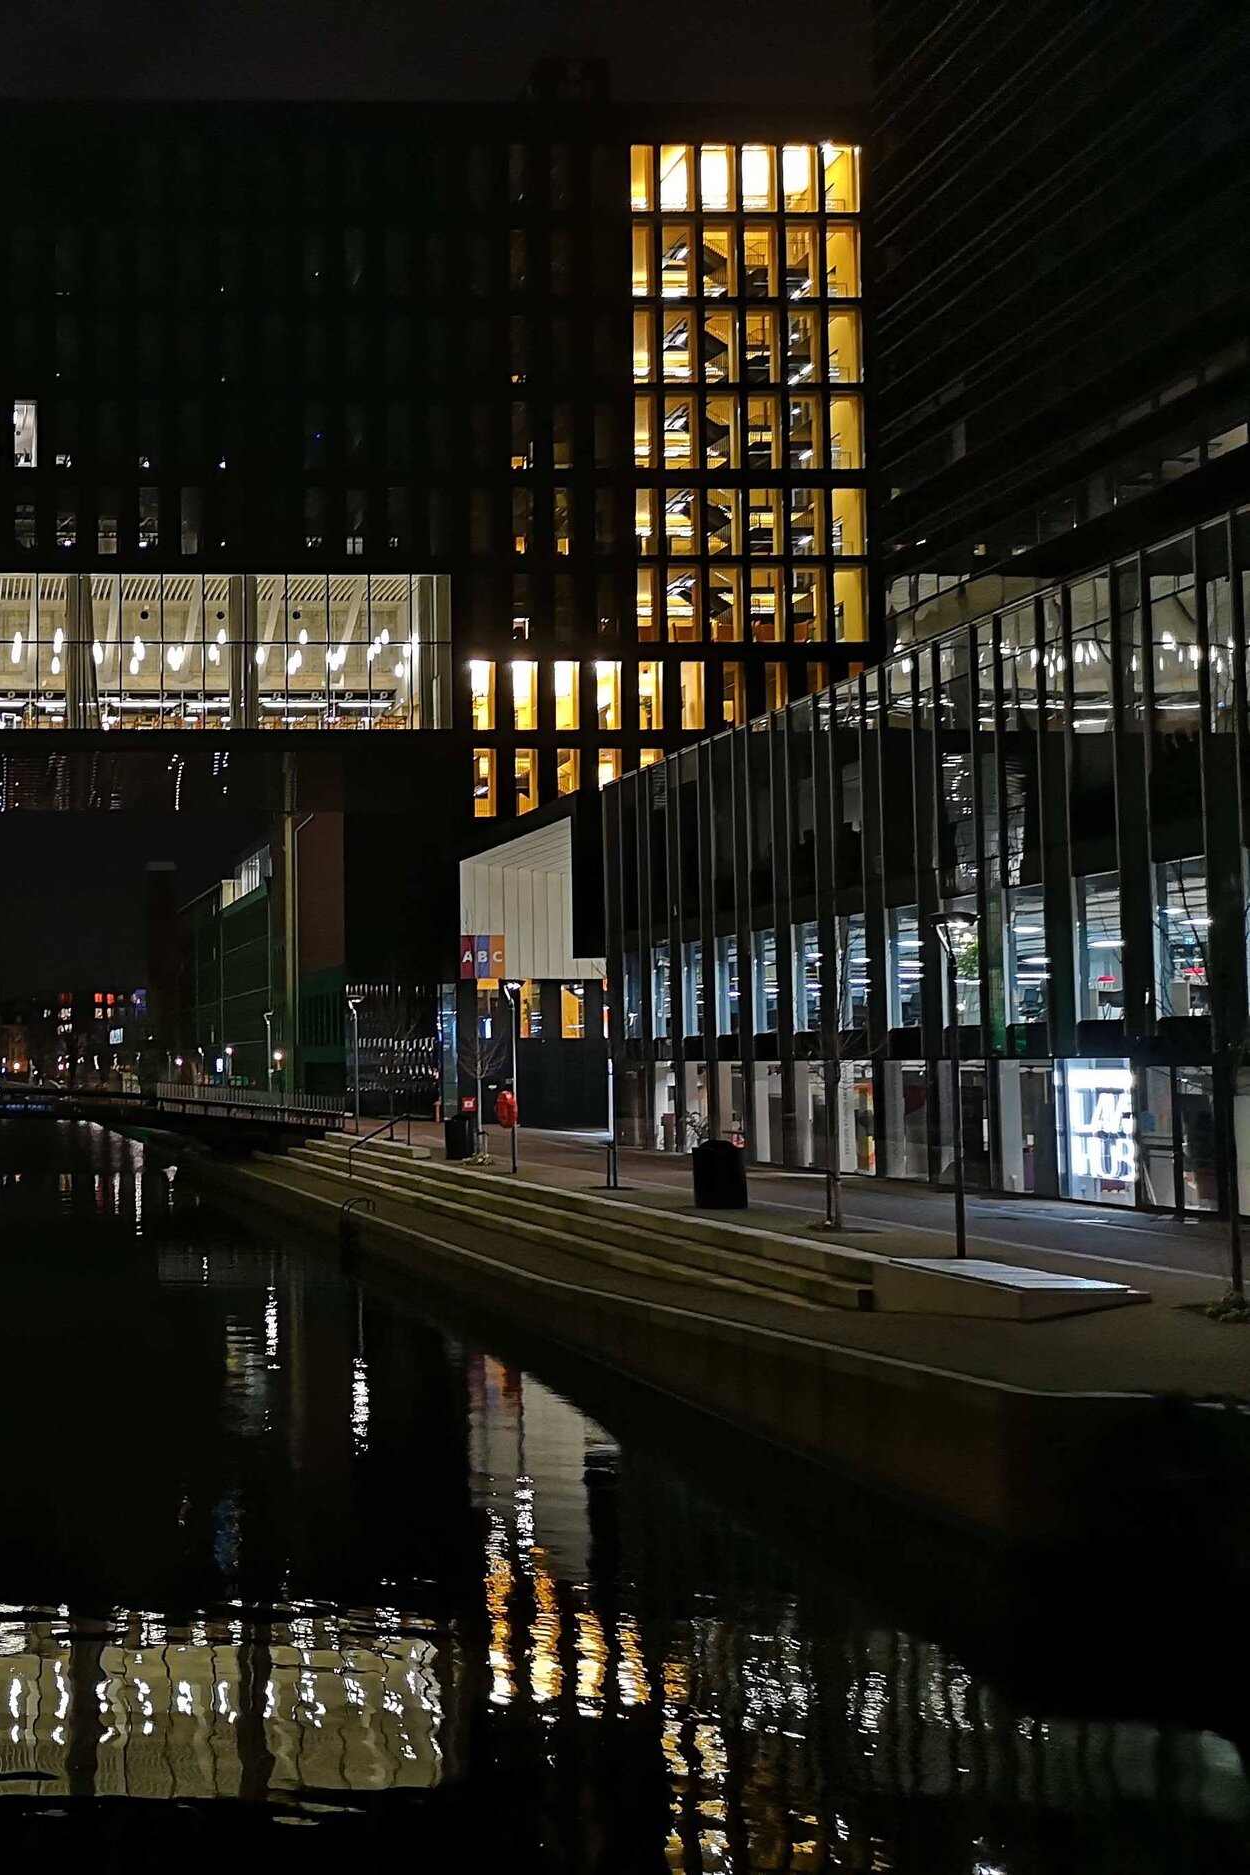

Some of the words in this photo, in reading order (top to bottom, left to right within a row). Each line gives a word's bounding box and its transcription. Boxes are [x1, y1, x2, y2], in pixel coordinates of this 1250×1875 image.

[462, 950, 473, 963] A
[477, 950, 488, 963] B
[492, 950, 503, 963] C
[1071, 1136, 1136, 1181] HUB
